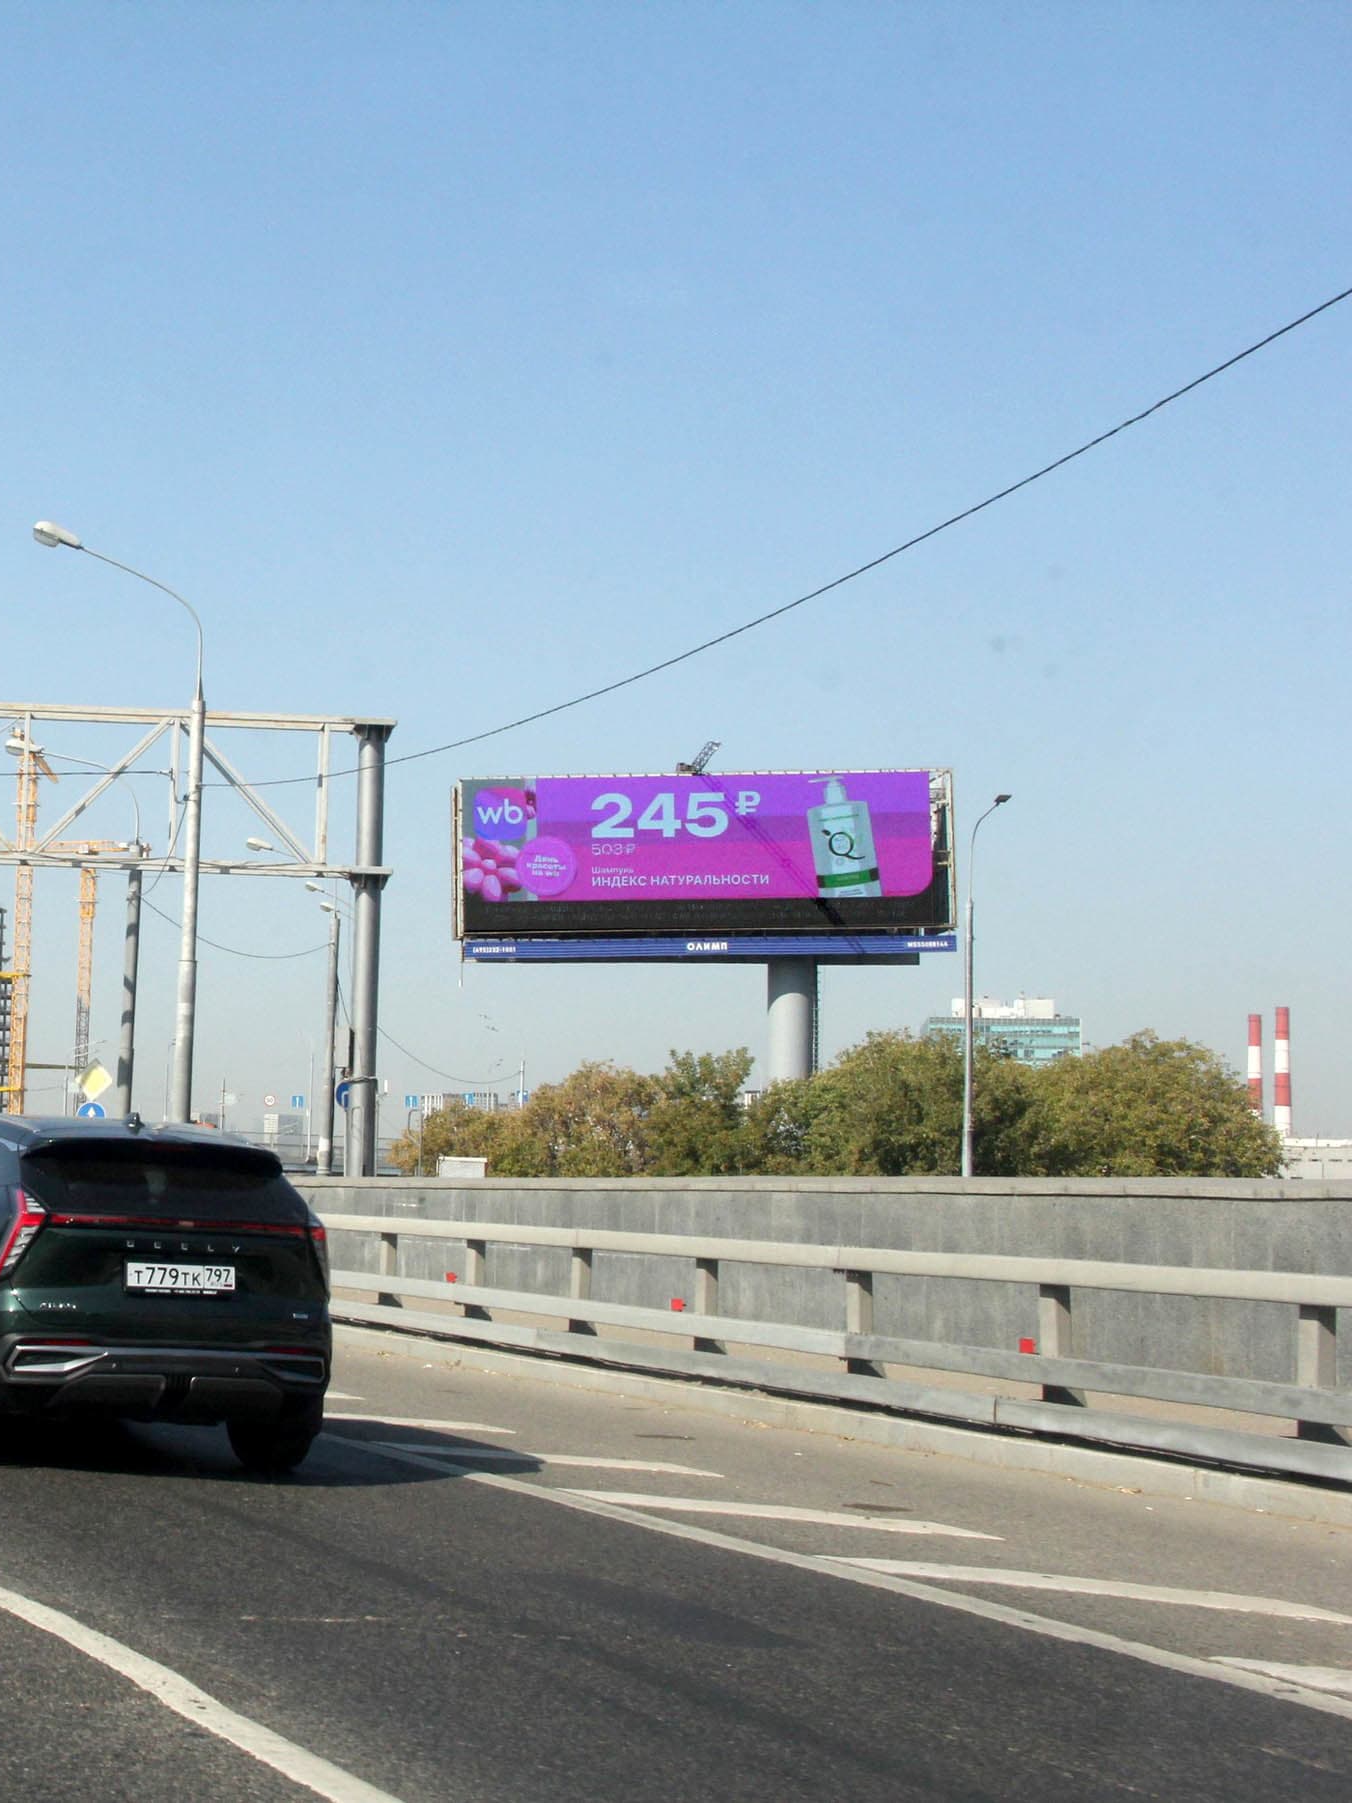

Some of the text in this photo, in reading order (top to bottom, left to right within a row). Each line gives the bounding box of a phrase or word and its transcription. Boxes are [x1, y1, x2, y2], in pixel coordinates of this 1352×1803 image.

[476, 798, 523, 824] wb
[591, 874, 770, 888] ИНДЕКС НАТУРАЛЬНОСТИ
[687, 942, 728, 951] ОЛИМП
[134, 1266, 201, 1286] Т779ТК
